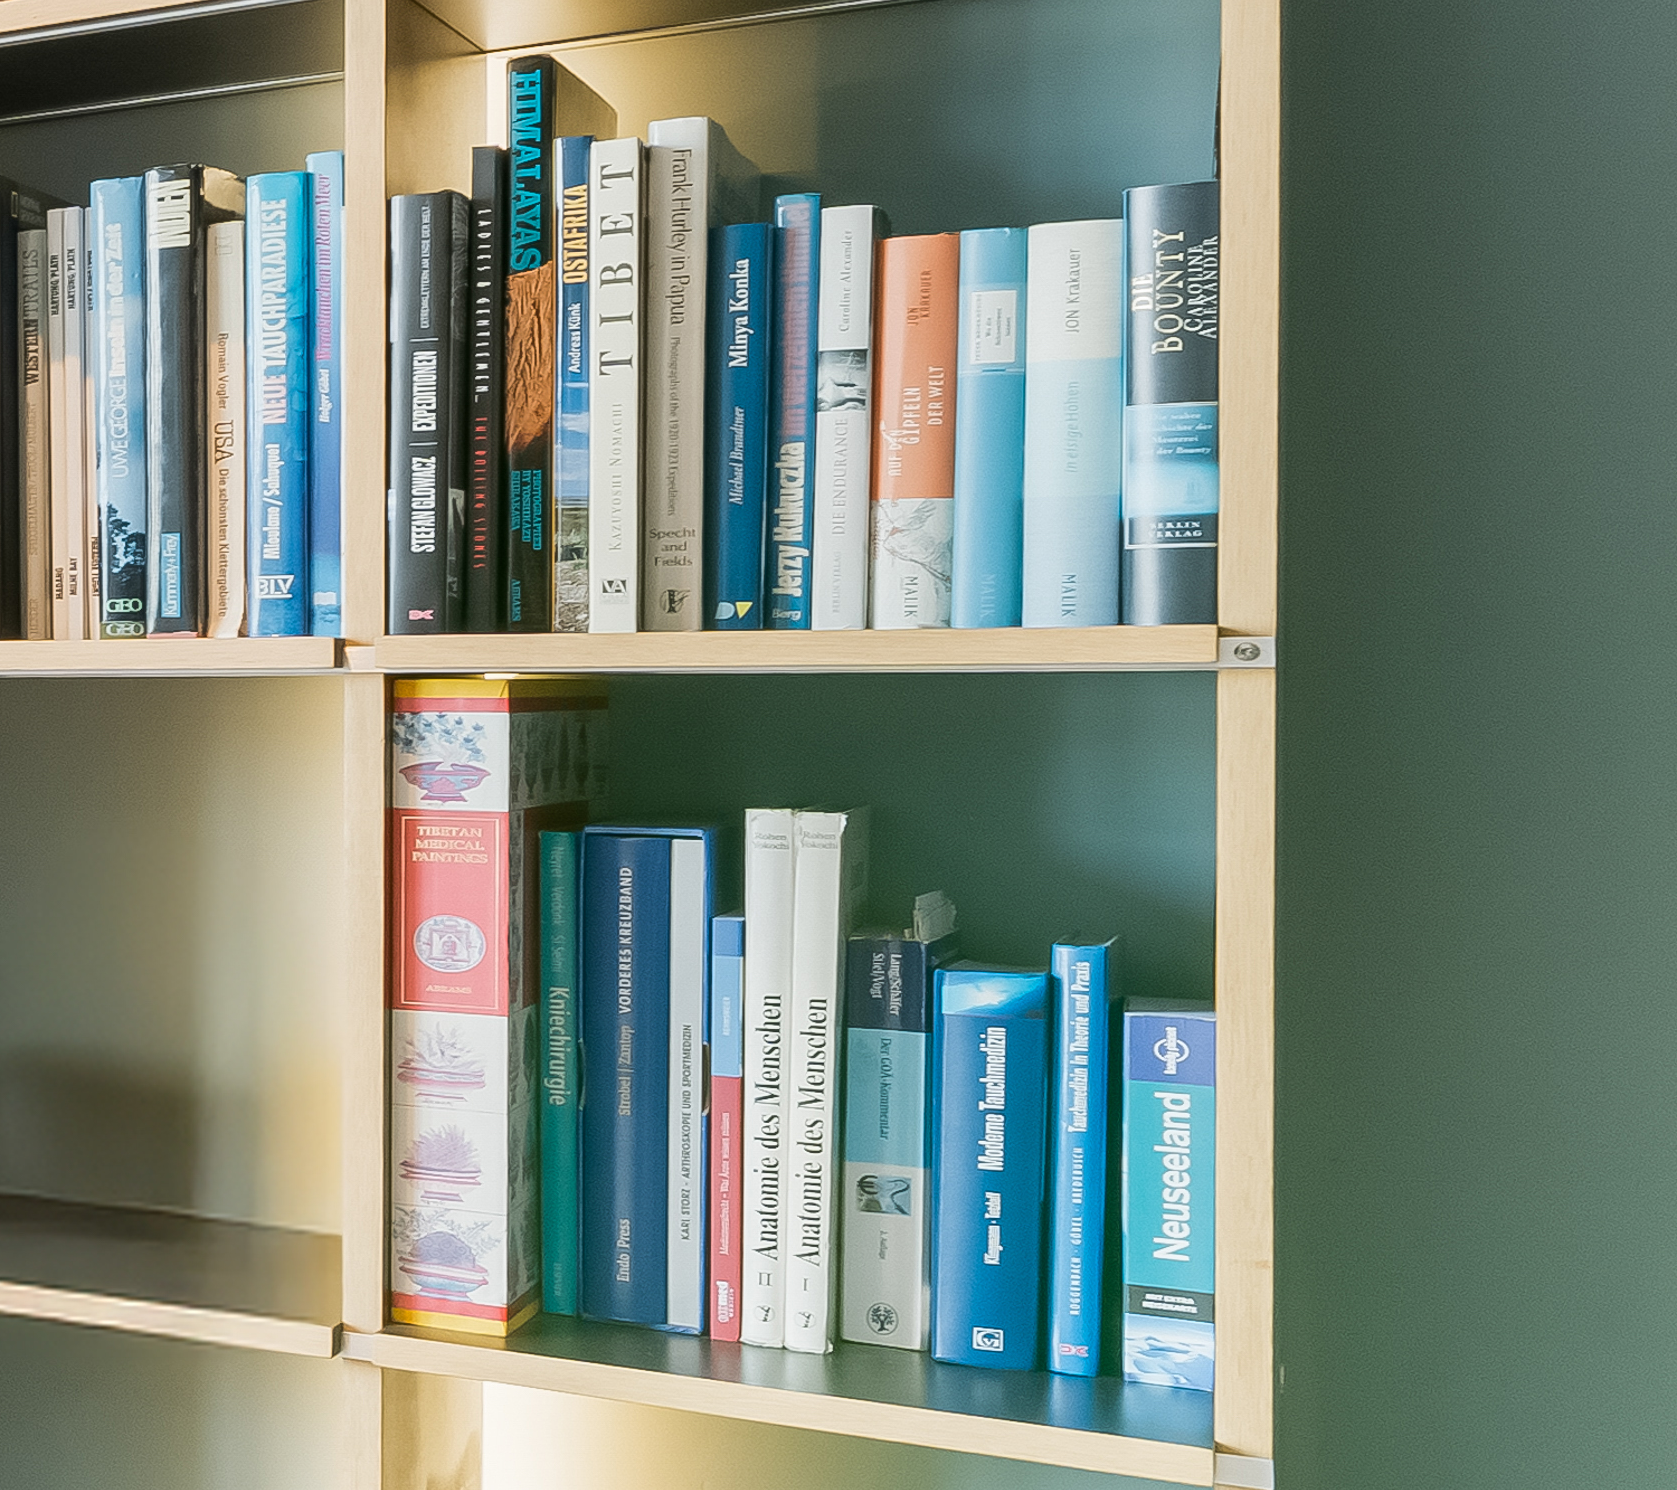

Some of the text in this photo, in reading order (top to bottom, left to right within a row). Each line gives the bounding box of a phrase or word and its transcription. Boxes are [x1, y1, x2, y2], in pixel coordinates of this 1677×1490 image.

[562, 184, 588, 285] OSTAFRIKA
[598, 163, 635, 378] TIBET
[729, 257, 750, 312] Konka
[727, 316, 755, 368] Minya
[1132, 272, 1154, 311] DIE
[1152, 228, 1184, 354] BOUNTY
[214, 420, 235, 465] USA
[410, 508, 436, 553] STEFAN
[414, 837, 486, 853] MEDICAL
[620, 867, 633, 1014] VORDERES KREUZBAND
[543, 986, 570, 1106] Kniechirurgie
[752, 993, 782, 1262] Anatomie des Menschen
[793, 995, 828, 1267] Anatomie des Menschen
[1153, 1091, 1191, 1262] Neuseeland
